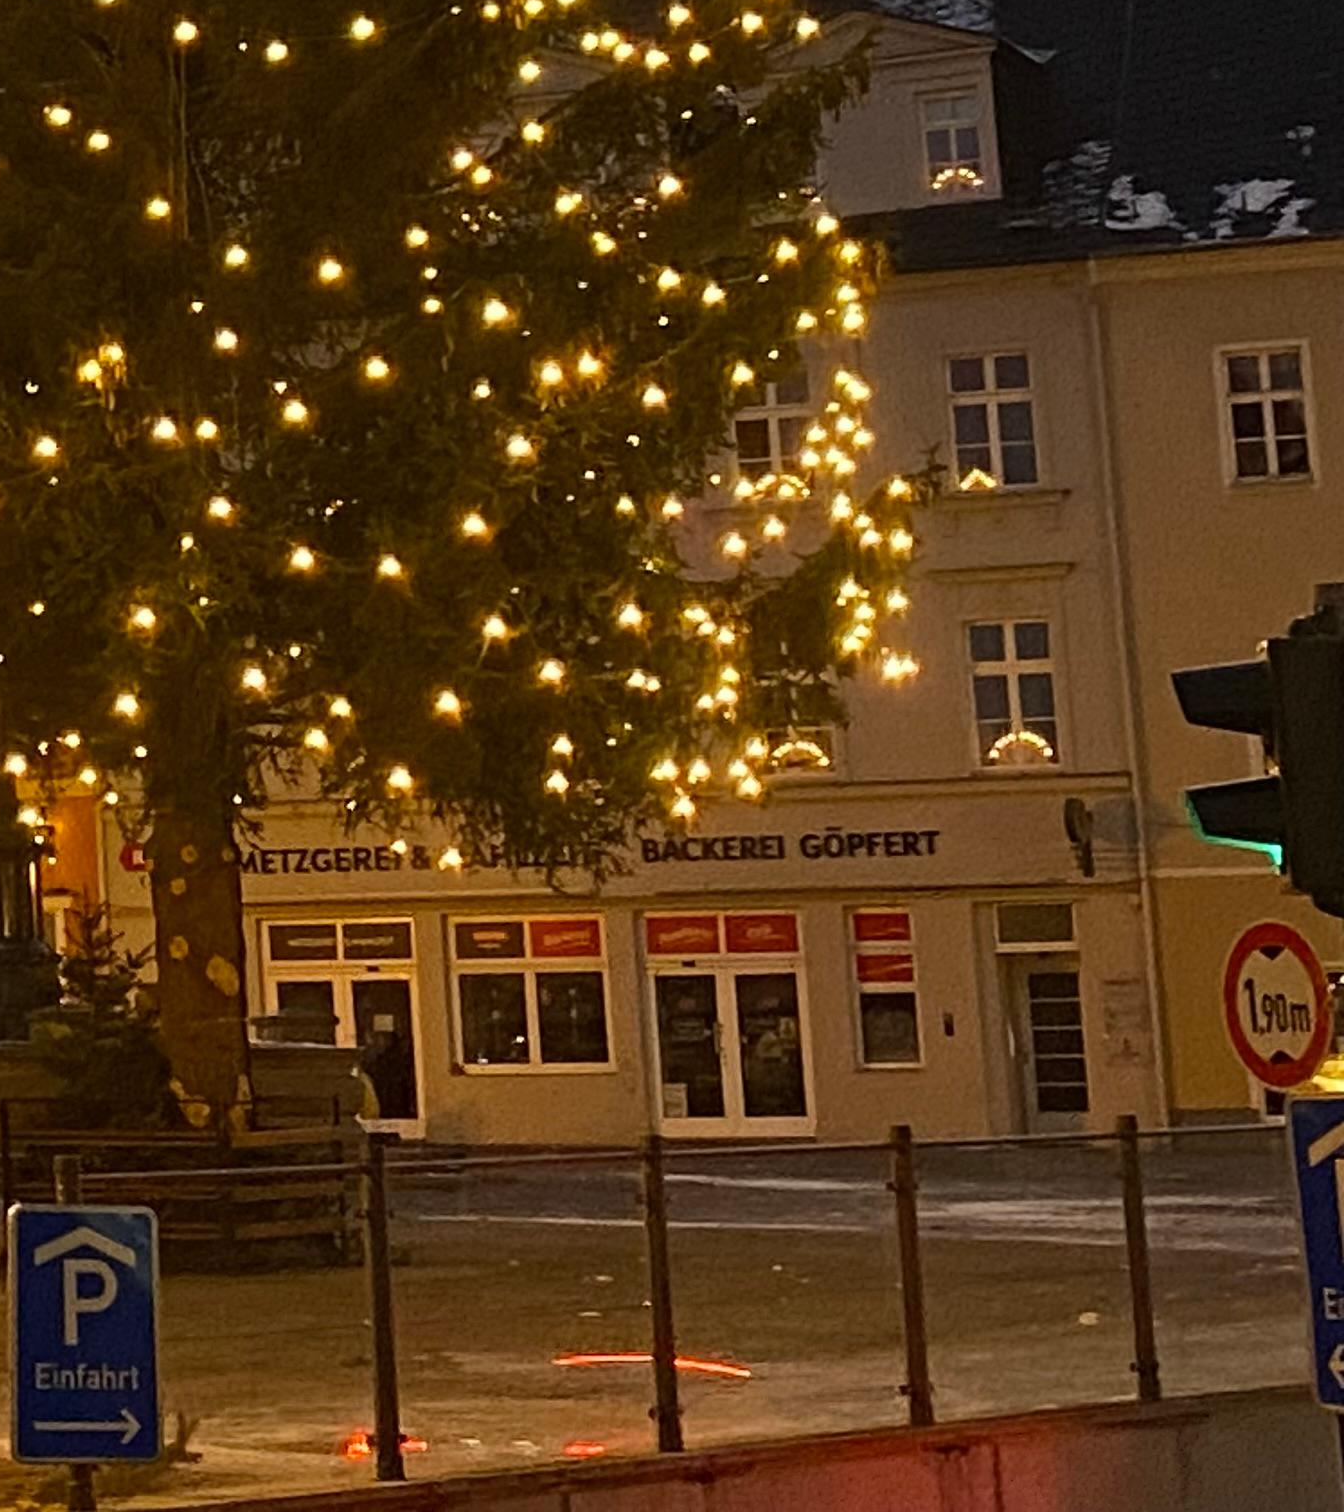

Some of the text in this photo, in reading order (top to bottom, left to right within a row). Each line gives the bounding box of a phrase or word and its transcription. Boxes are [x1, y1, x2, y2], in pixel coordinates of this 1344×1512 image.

[238, 845, 405, 874] METZGEREI
[410, 843, 432, 872] &
[799, 826, 940, 859] GÖPFERT
[63, 1258, 119, 1346] P
[34, 1361, 140, 1391] Einfahrt
